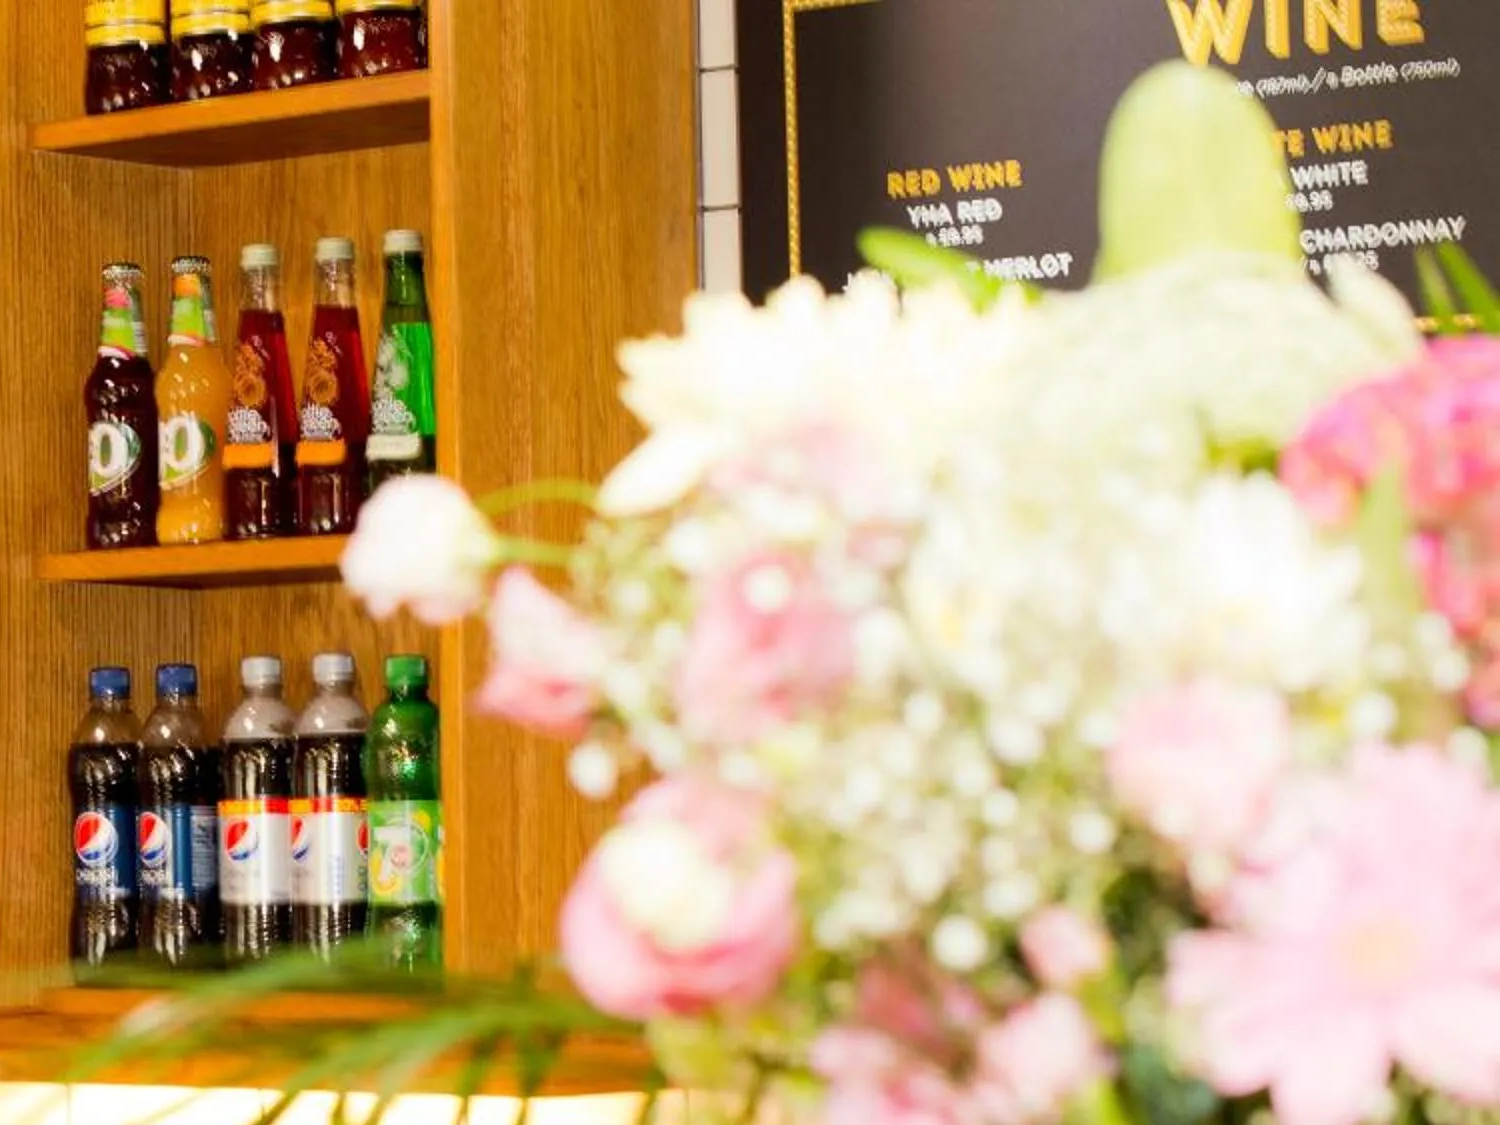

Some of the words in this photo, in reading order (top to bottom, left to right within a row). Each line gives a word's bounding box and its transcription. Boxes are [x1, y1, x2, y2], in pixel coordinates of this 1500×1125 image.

[1340, 60, 1398, 88] Bottle
[1311, 119, 1393, 154] WINE
[886, 168, 941, 199] RED
[947, 159, 1023, 192] WINE
[1289, 159, 1368, 190] WHITE
[956, 197, 1003, 224] RED
[1300, 215, 1466, 254] CHARDONNAY
[984, 252, 1073, 280] MERLOT
